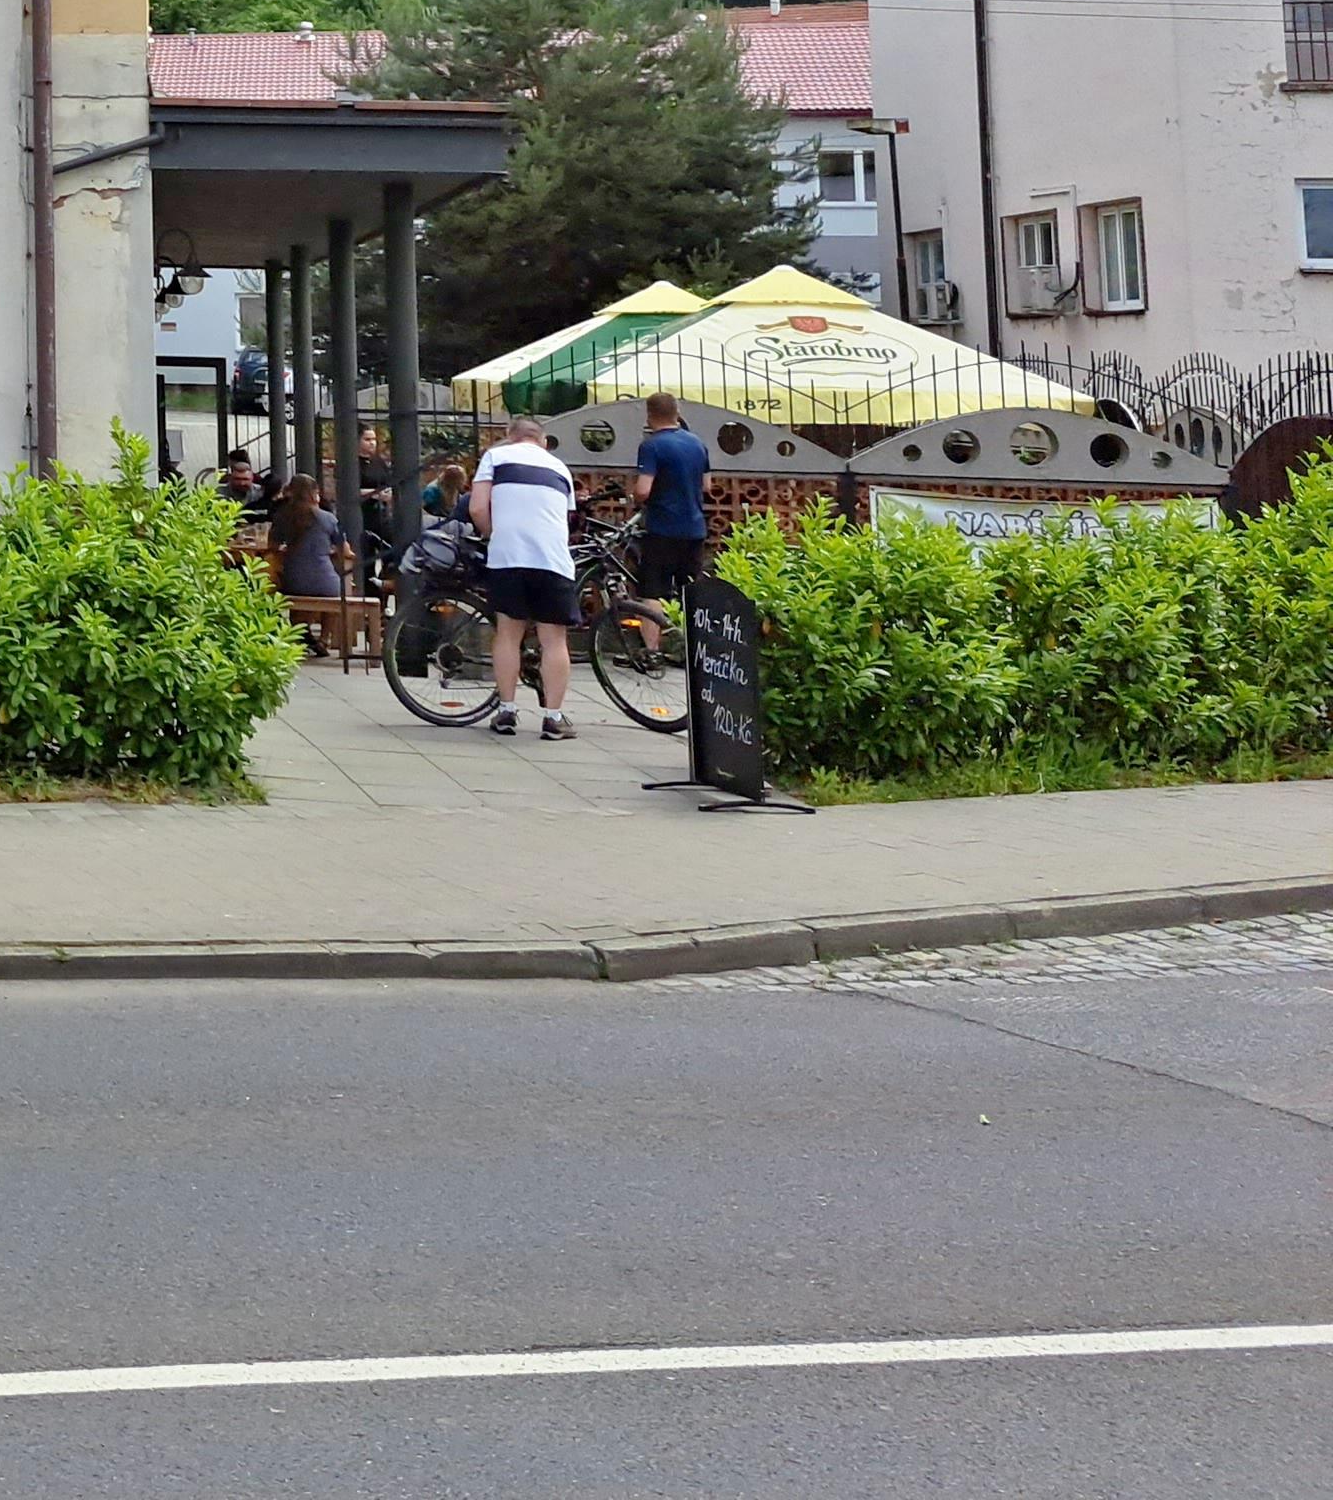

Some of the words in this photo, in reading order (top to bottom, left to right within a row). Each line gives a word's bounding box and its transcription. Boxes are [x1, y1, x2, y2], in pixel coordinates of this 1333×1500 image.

[747, 336, 897, 366] Starobrno
[736, 398, 782, 411] 1872
[701, 681, 715, 704] od
